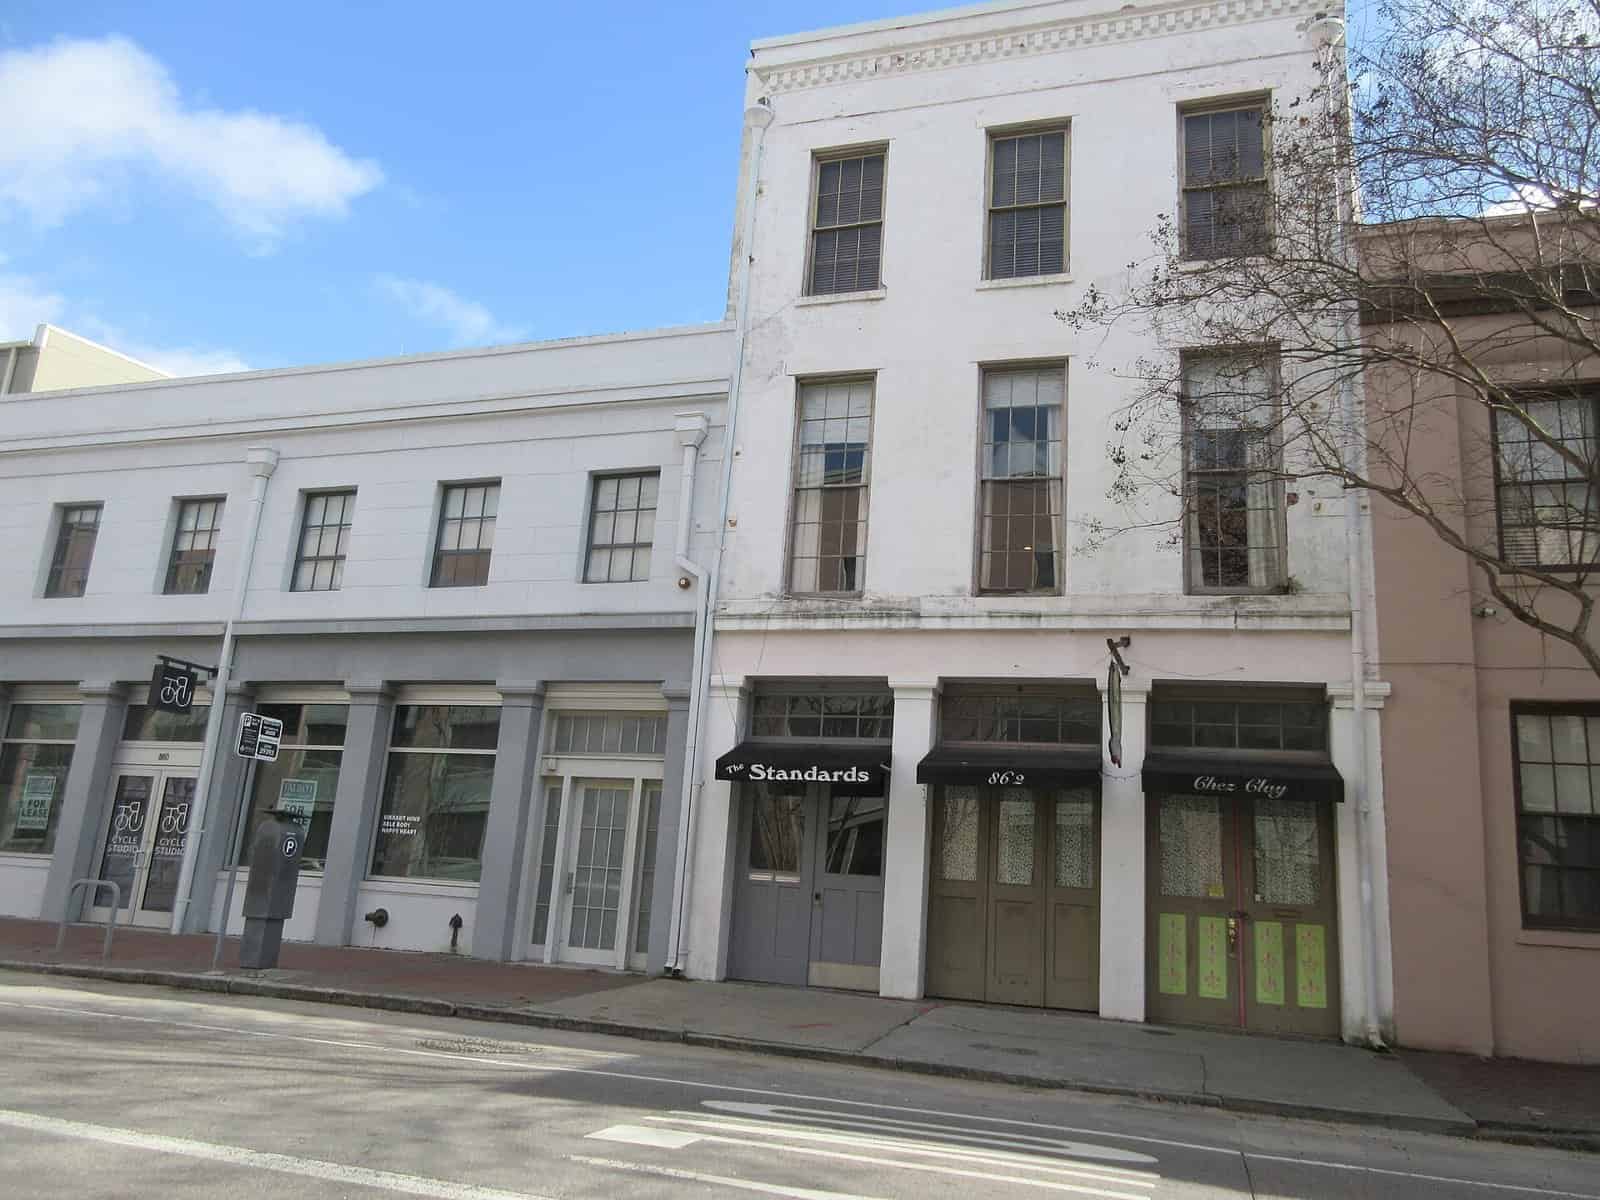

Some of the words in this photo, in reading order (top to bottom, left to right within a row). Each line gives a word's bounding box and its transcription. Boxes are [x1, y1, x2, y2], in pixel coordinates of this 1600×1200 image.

[726, 763, 744, 774] The
[749, 764, 869, 782] Standards
[988, 770, 1025, 785] 862
[1194, 776, 1236, 791] Chez
[1245, 779, 1287, 799] Clay
[27, 799, 47, 808] FOR
[21, 807, 49, 817] LEASE
[112, 835, 138, 844] CYCLE
[107, 844, 139, 853] STUDIO
[286, 840, 295, 853] P
